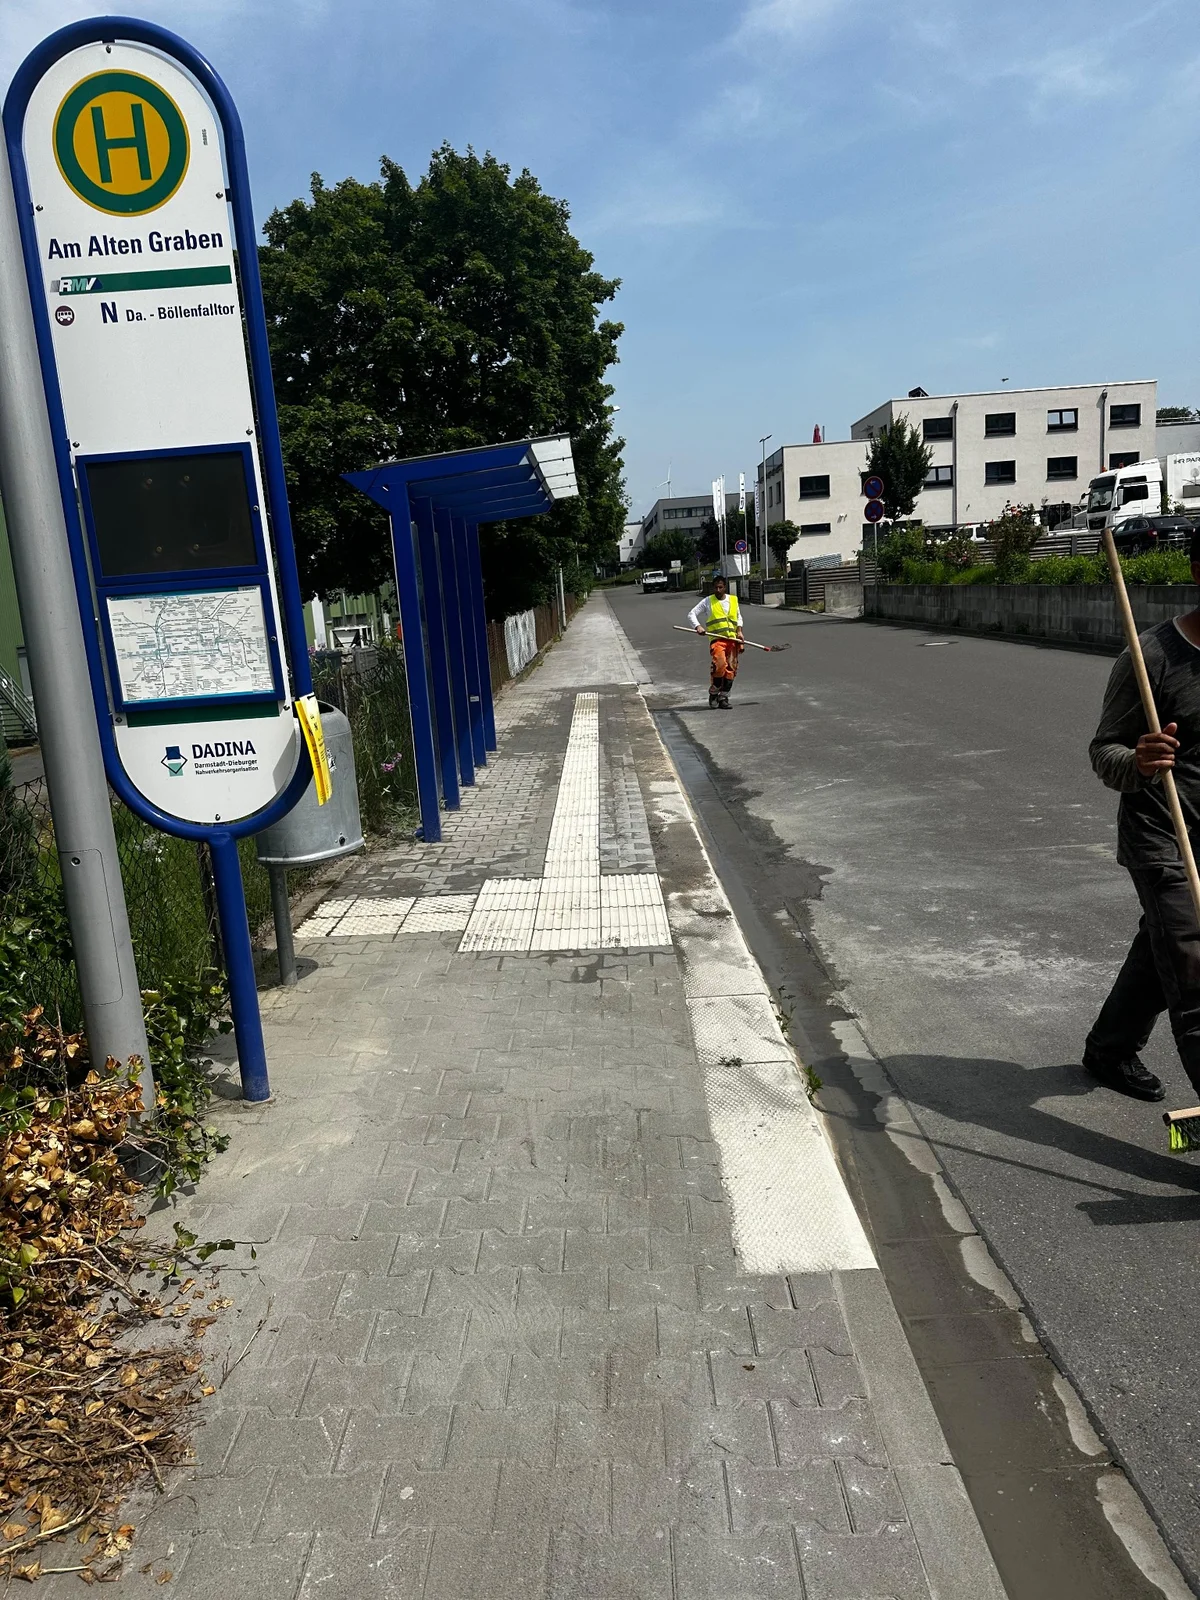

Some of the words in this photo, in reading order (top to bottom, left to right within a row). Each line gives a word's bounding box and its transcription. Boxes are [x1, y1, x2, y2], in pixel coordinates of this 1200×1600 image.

[91, 103, 152, 184] H
[48, 238, 81, 259] Am
[88, 235, 142, 257] Alten
[148, 229, 223, 252] Graben
[59, 277, 97, 292] RMV
[100, 301, 118, 323] N
[126, 309, 147, 322] Da.
[158, 303, 235, 320] Böllenfalltor
[192, 740, 256, 759] DADINA
[194, 759, 258, 769] Darmstadt-Dieburger
[195, 765, 259, 775] Nahverkehrsorganisation
